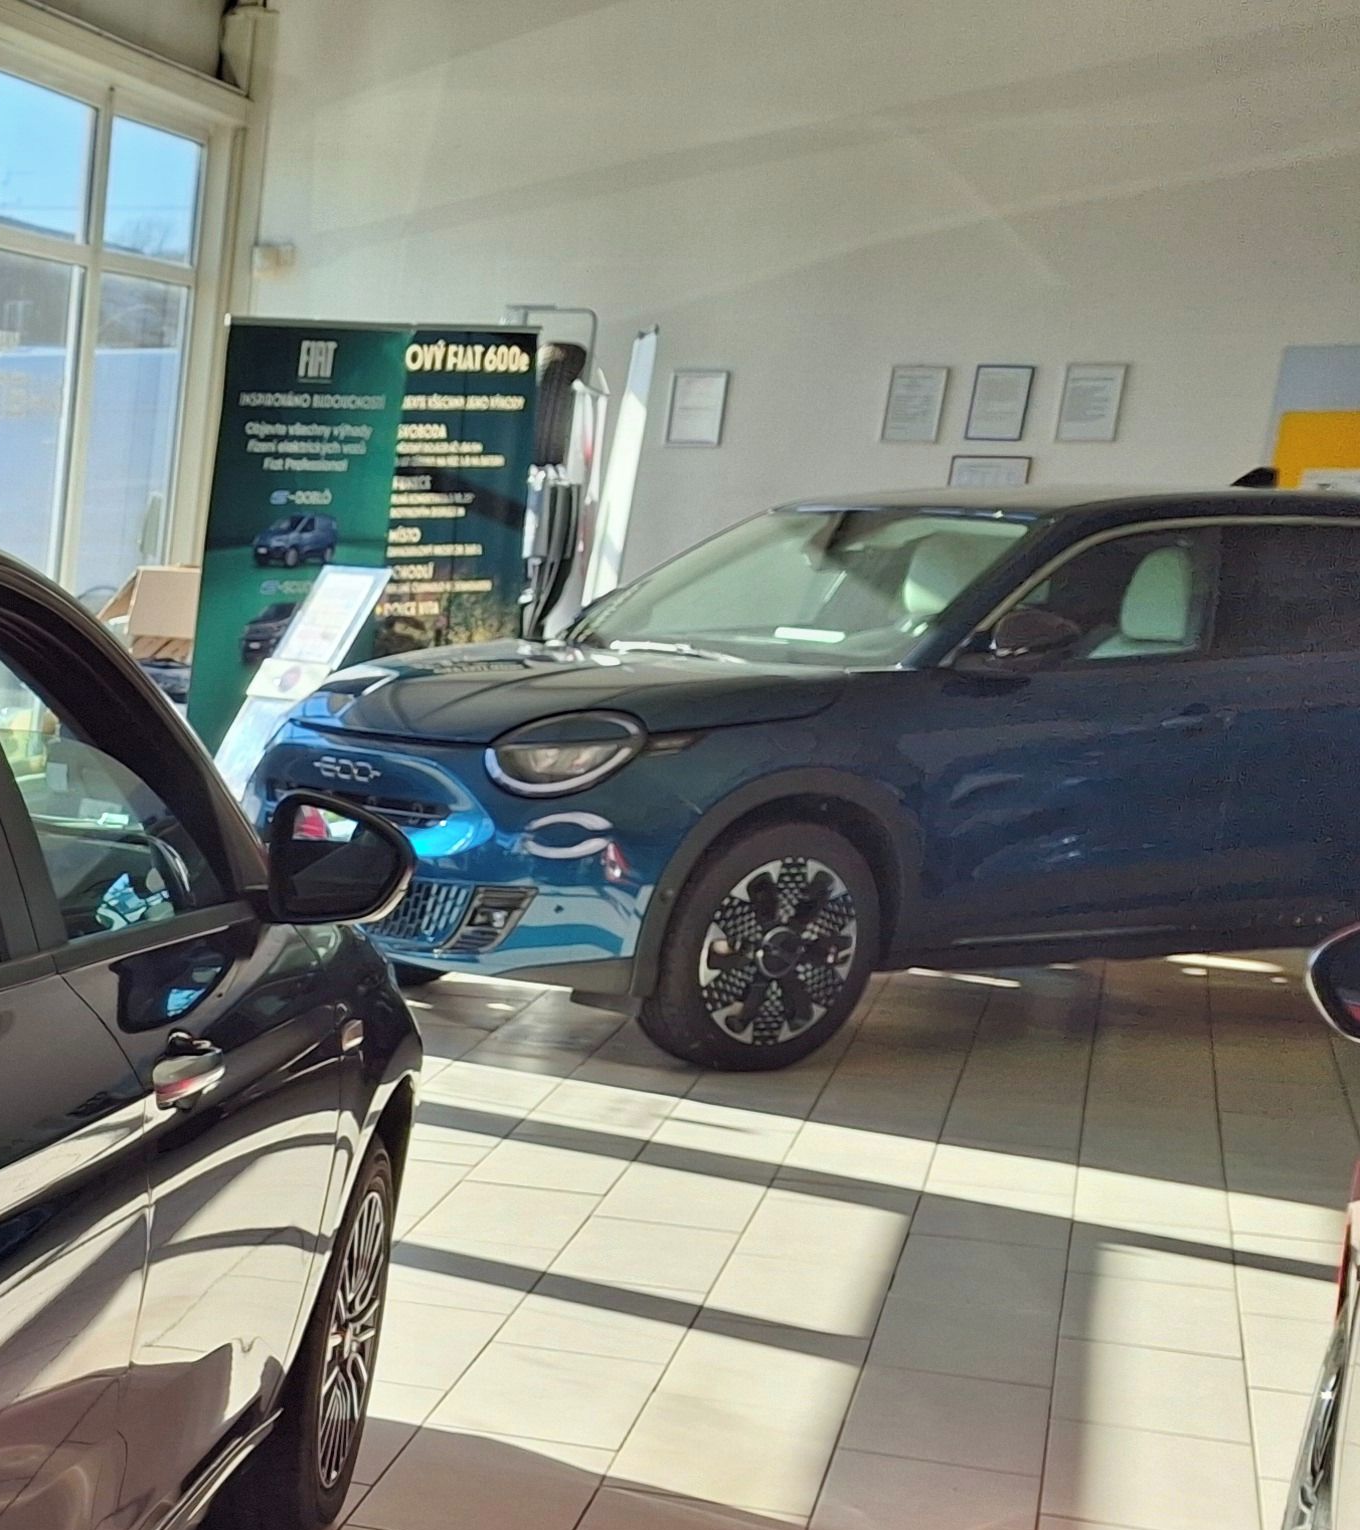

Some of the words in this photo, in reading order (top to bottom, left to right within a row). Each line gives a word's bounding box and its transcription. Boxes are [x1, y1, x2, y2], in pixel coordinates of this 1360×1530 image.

[298, 340, 338, 377] FIAT
[446, 344, 485, 371] FIAT
[484, 345, 529, 372] 600e
[391, 562, 435, 580] OHODLÍ
